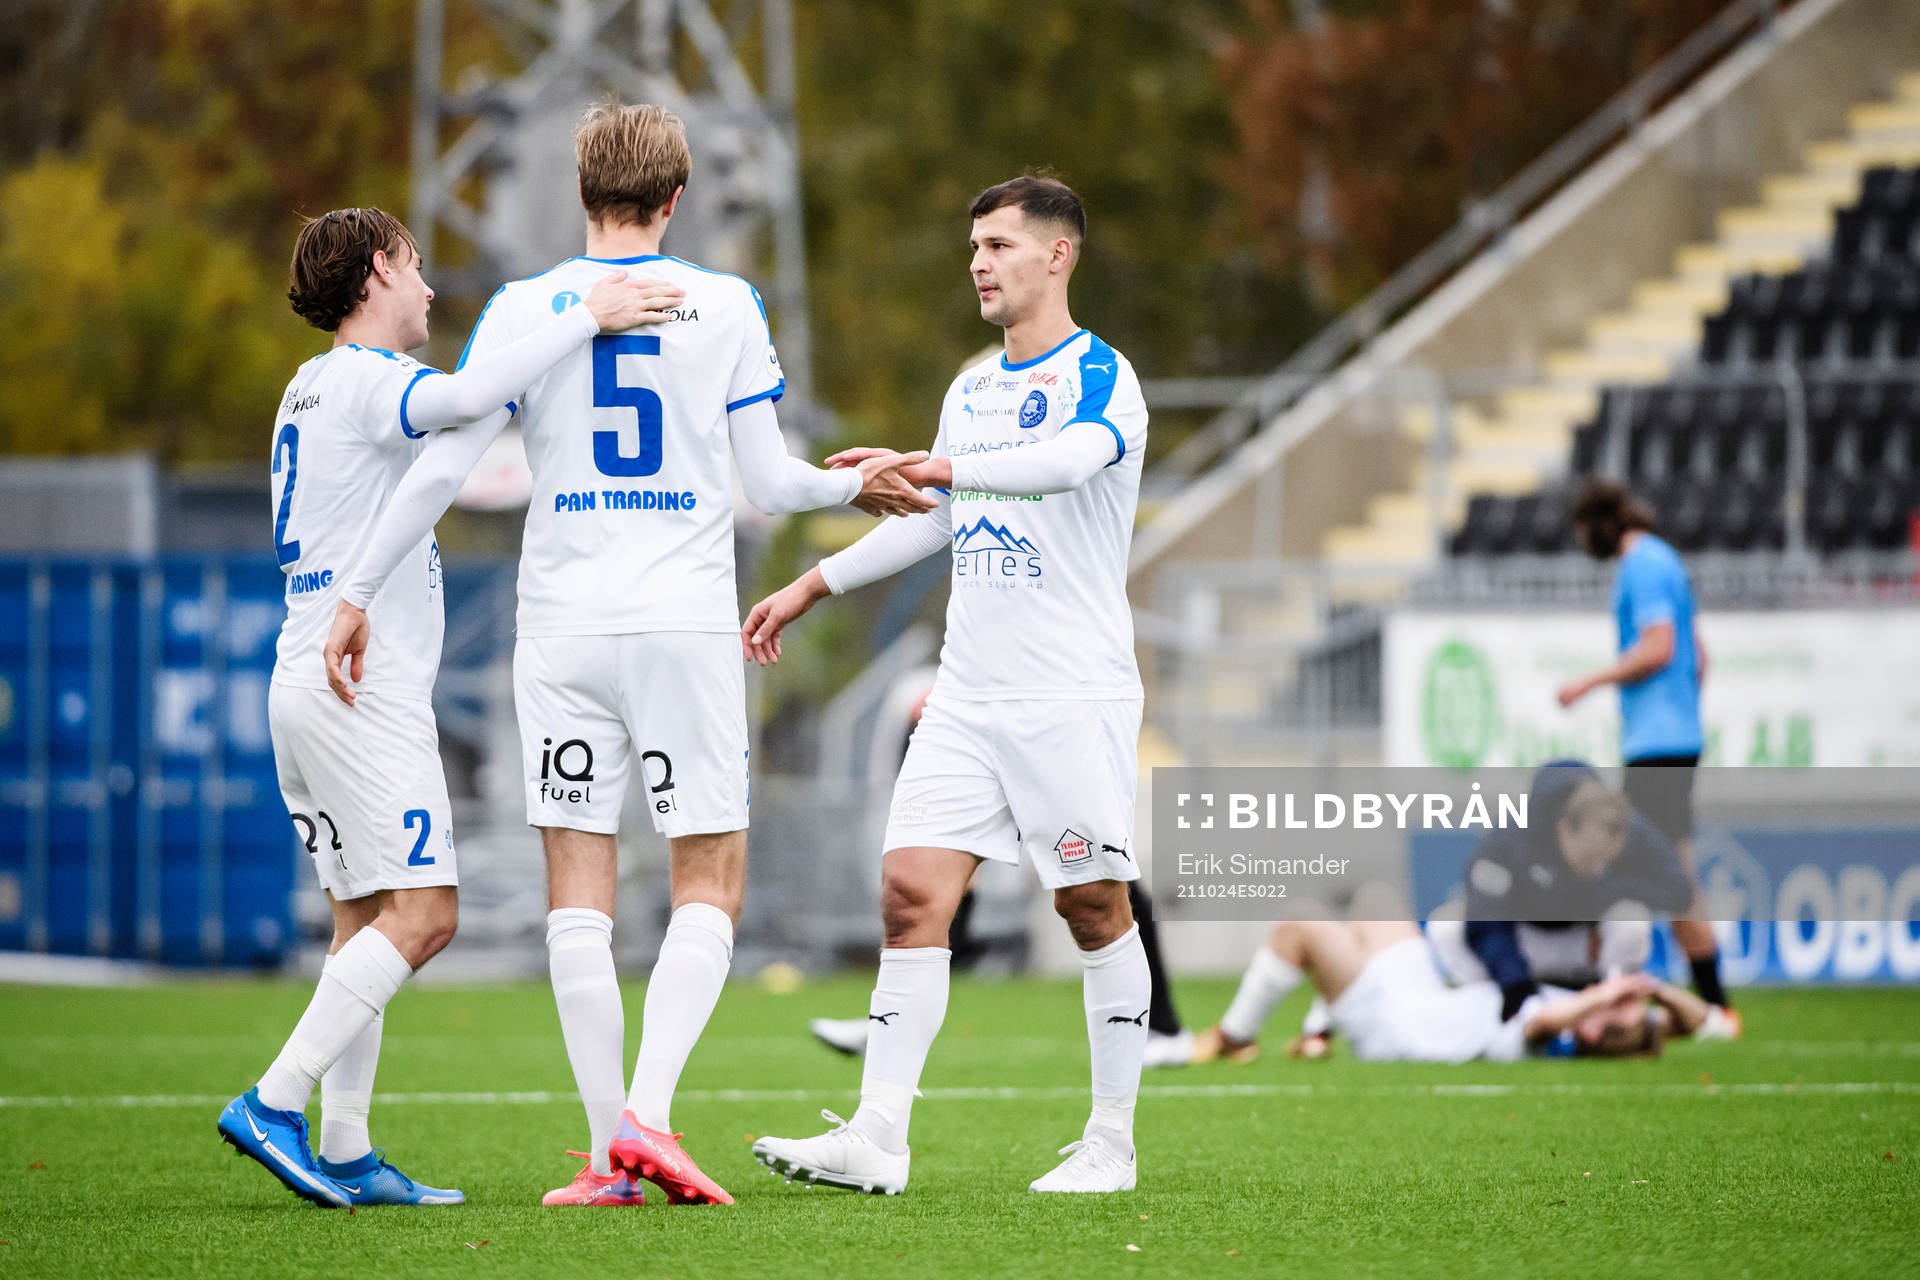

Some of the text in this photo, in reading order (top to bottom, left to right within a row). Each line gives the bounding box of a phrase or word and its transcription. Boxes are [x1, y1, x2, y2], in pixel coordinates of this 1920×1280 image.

[592, 334, 663, 478] 5
[271, 422, 301, 567] 2
[554, 490, 697, 513] PAN TRADING
[290, 569, 335, 595] ADING
[541, 737, 594, 782] iQ
[540, 782, 591, 804] fuel
[655, 794, 678, 814] el
[403, 808, 436, 867] 2
[640, 1132, 681, 1175] ULTRA
